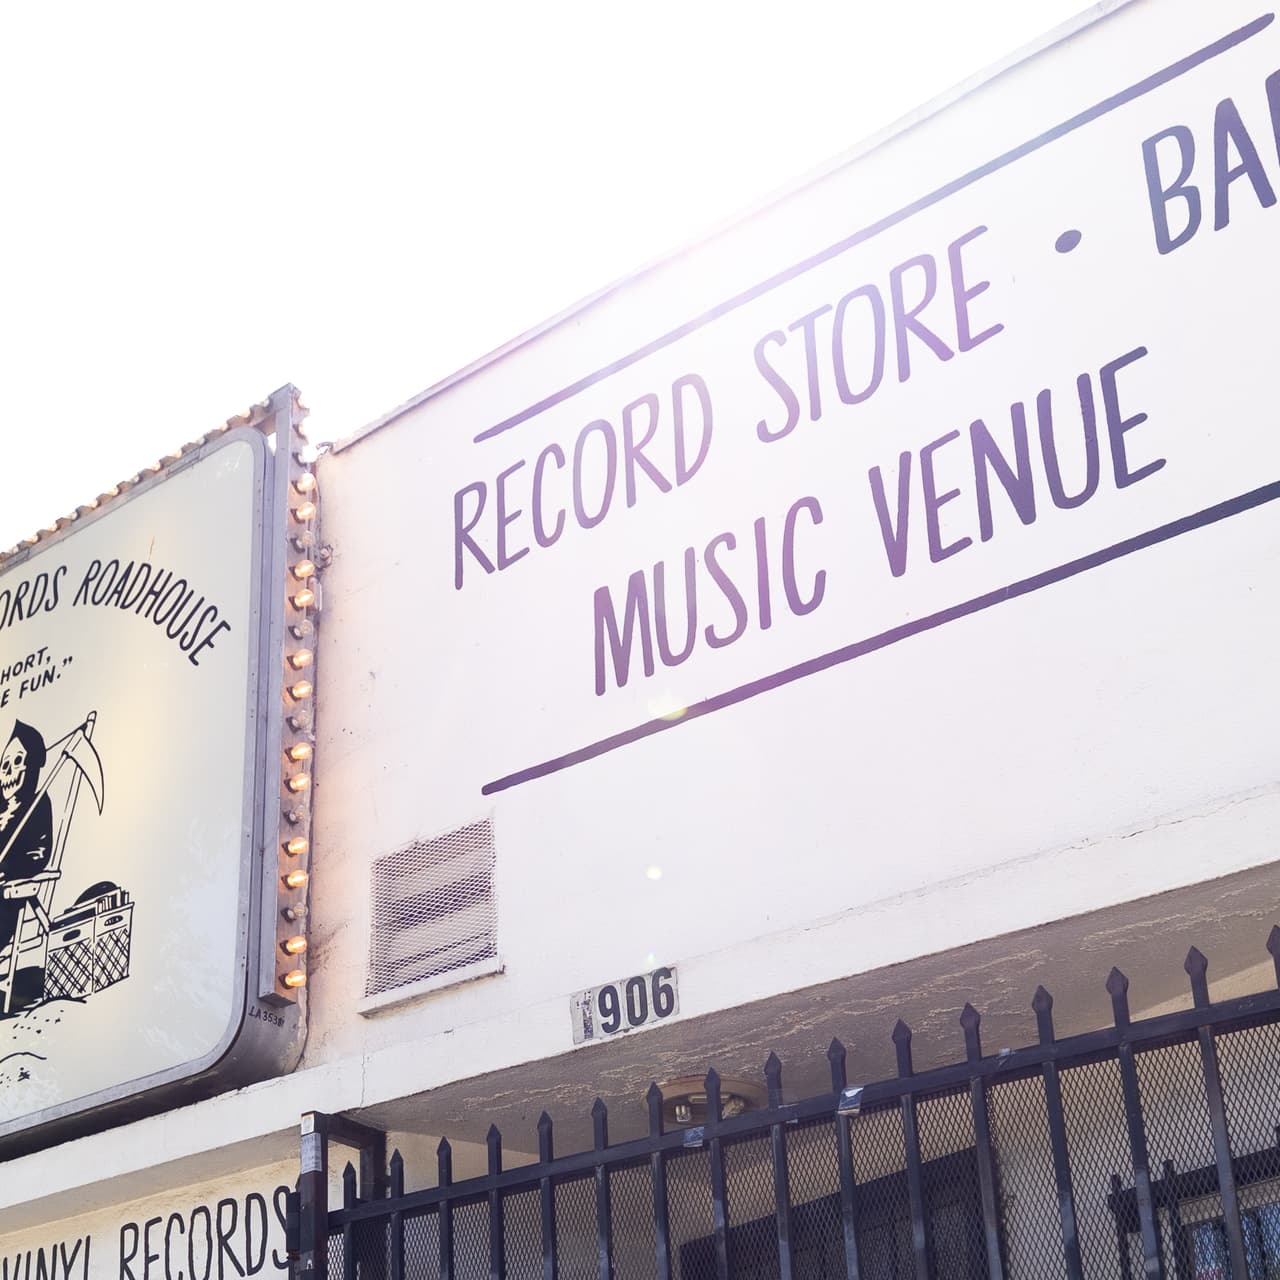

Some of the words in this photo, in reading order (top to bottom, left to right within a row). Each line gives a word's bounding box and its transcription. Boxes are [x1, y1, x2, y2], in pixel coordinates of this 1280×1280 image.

[453, 372, 713, 590] RECORD
[752, 224, 1005, 444] STORE
[591, 494, 827, 697] MUSIC
[869, 345, 1167, 578] VENUE
[72, 559, 232, 667] ROADHOUSE
